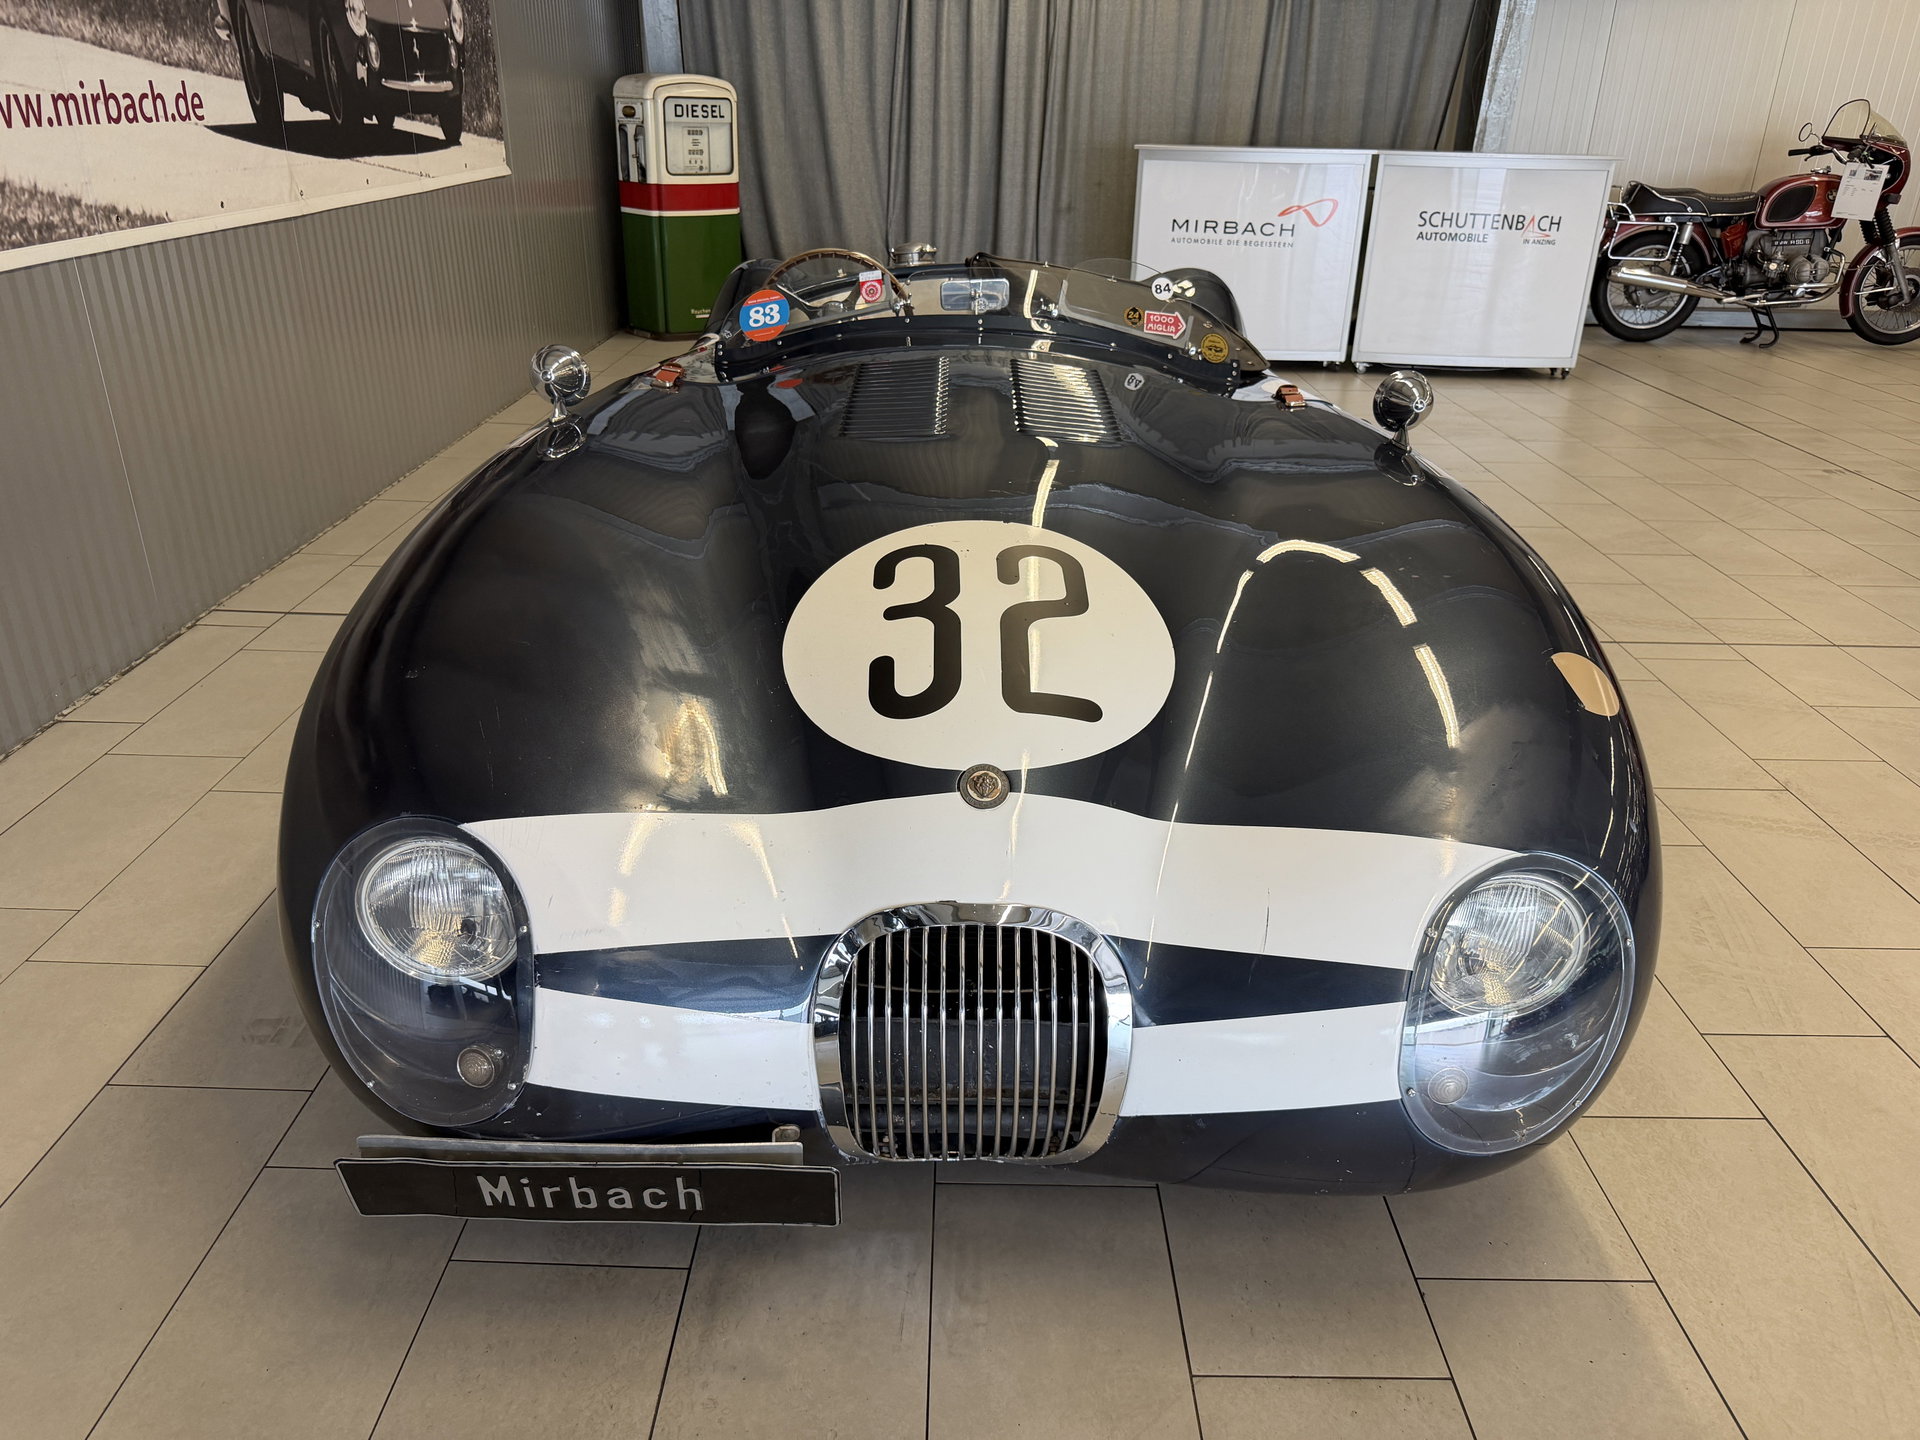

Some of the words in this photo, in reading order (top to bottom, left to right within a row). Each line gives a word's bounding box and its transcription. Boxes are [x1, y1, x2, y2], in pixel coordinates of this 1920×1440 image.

[674, 104, 725, 119] DIESEL
[1171, 218, 1296, 237] MIRBACH
[1418, 211, 1562, 235] SCHUTTENBACH
[1170, 237, 1223, 246] AUTOMOBILE
[1243, 240, 1294, 248] BEGEISTERN
[1416, 231, 1489, 243] AUTOMOBILE
[1154, 283, 1171, 294] 84
[748, 303, 781, 328] 83
[1127, 311, 1140, 319] 24
[1149, 315, 1175, 324] 1000
[1147, 323, 1176, 333] MIGLIA
[868, 543, 1104, 723] 32
[476, 1174, 704, 1211] Mirbach
